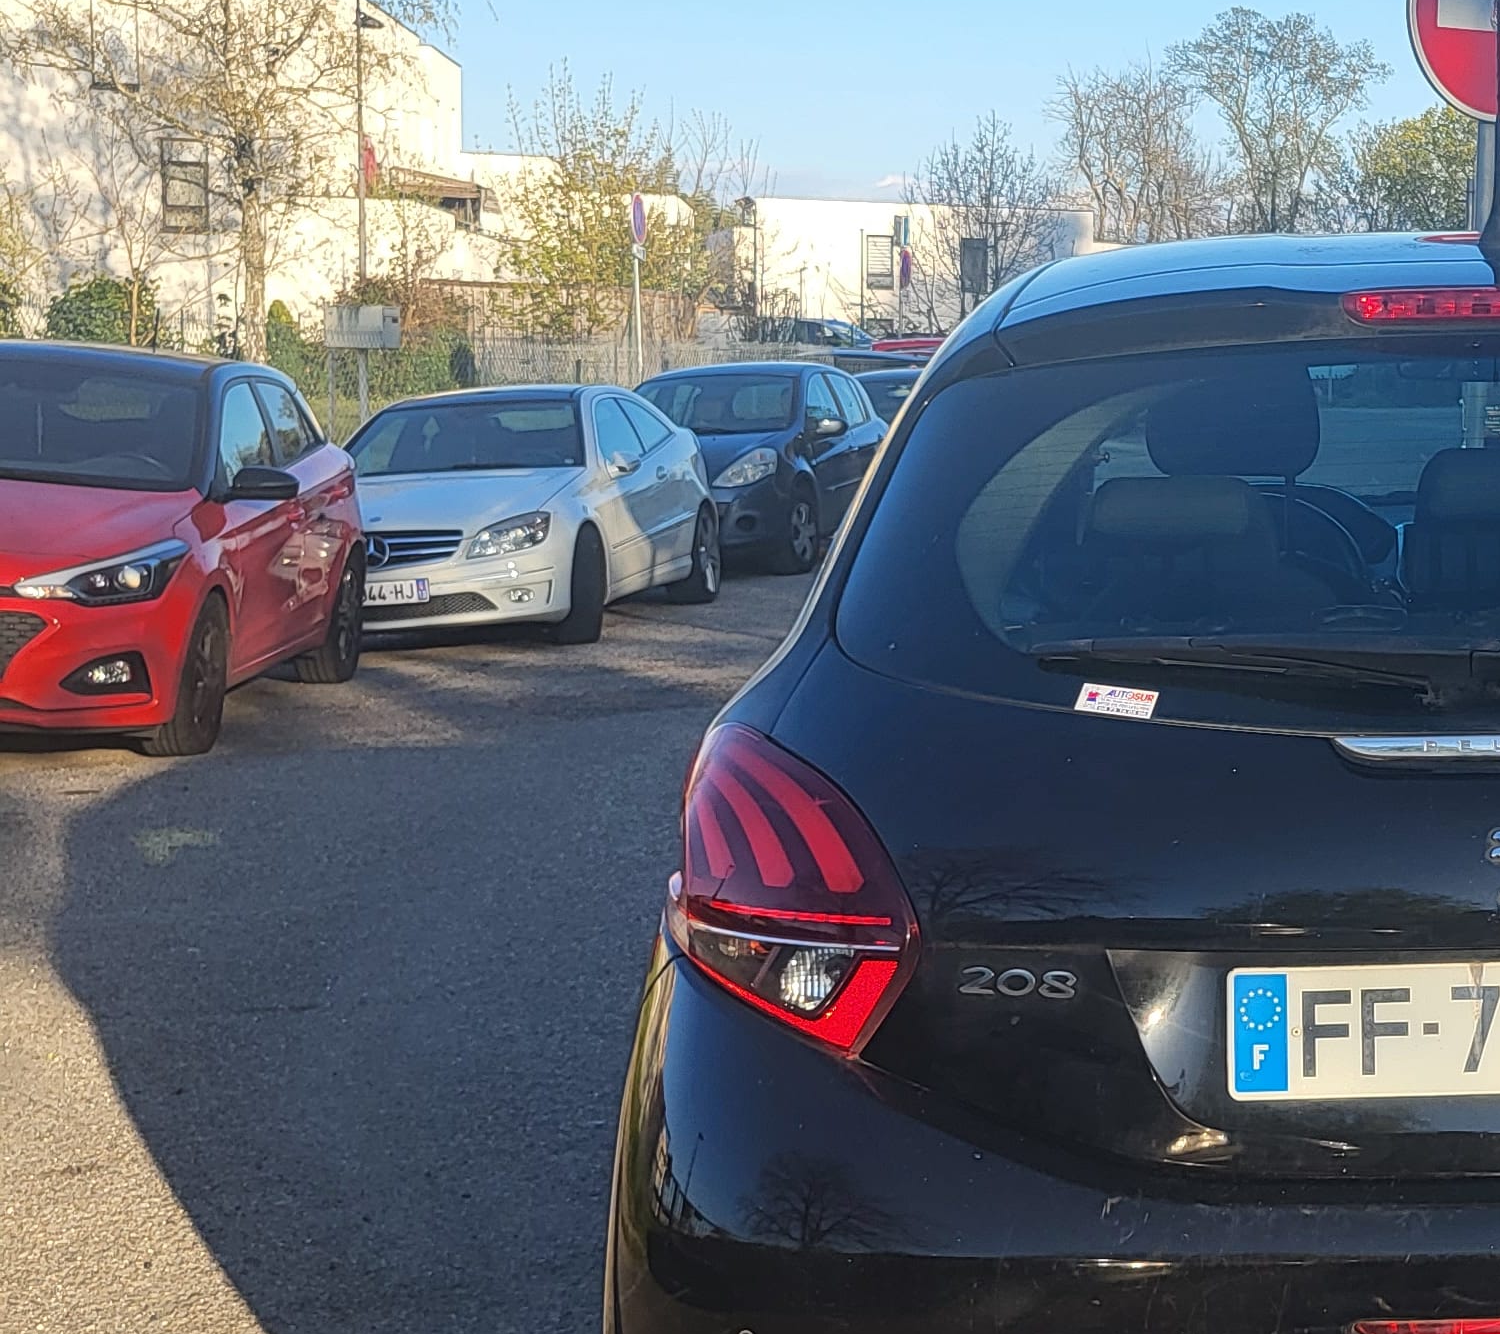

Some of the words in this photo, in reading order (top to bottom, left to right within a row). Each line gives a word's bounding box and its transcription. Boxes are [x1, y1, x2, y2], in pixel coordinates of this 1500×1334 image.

[368, 583, 415, 602] 44-HJ
[1105, 689, 1155, 702] AUTOSUR
[959, 966, 1078, 999] 208
[1252, 1044, 1270, 1071] F
